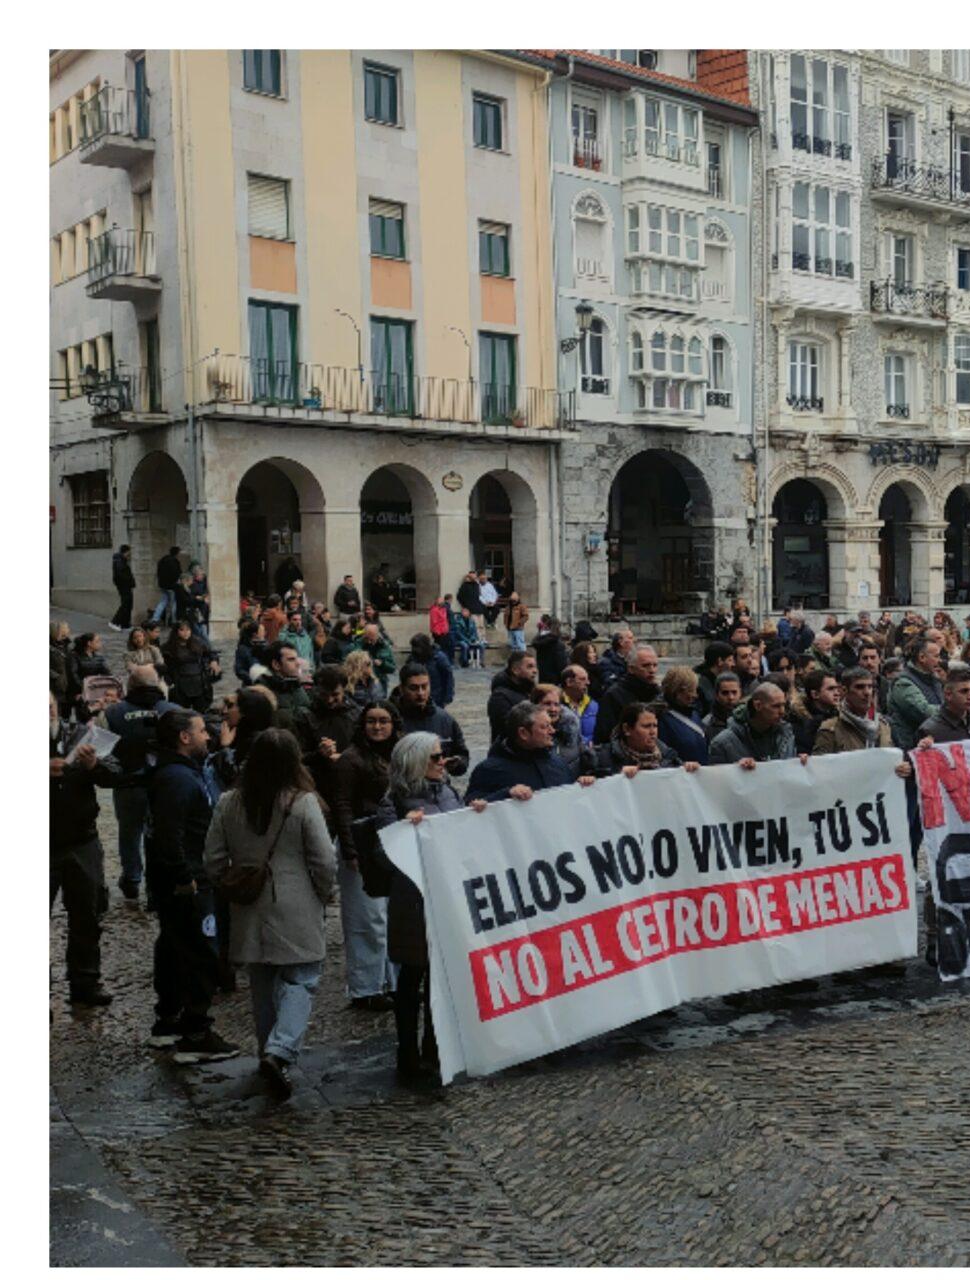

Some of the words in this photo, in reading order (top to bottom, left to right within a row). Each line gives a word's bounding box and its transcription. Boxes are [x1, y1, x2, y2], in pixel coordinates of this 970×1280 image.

[463, 851, 586, 935] ELLOS
[585, 834, 646, 894] NO
[686, 816, 802, 873] VIVEN,
[809, 798, 853, 856] TÚ
[856, 792, 891, 847] SÍ
[483, 943, 548, 1010] NO
[559, 923, 615, 986] AL
[736, 883, 783, 938] DE
[785, 862, 901, 927] MENAS
